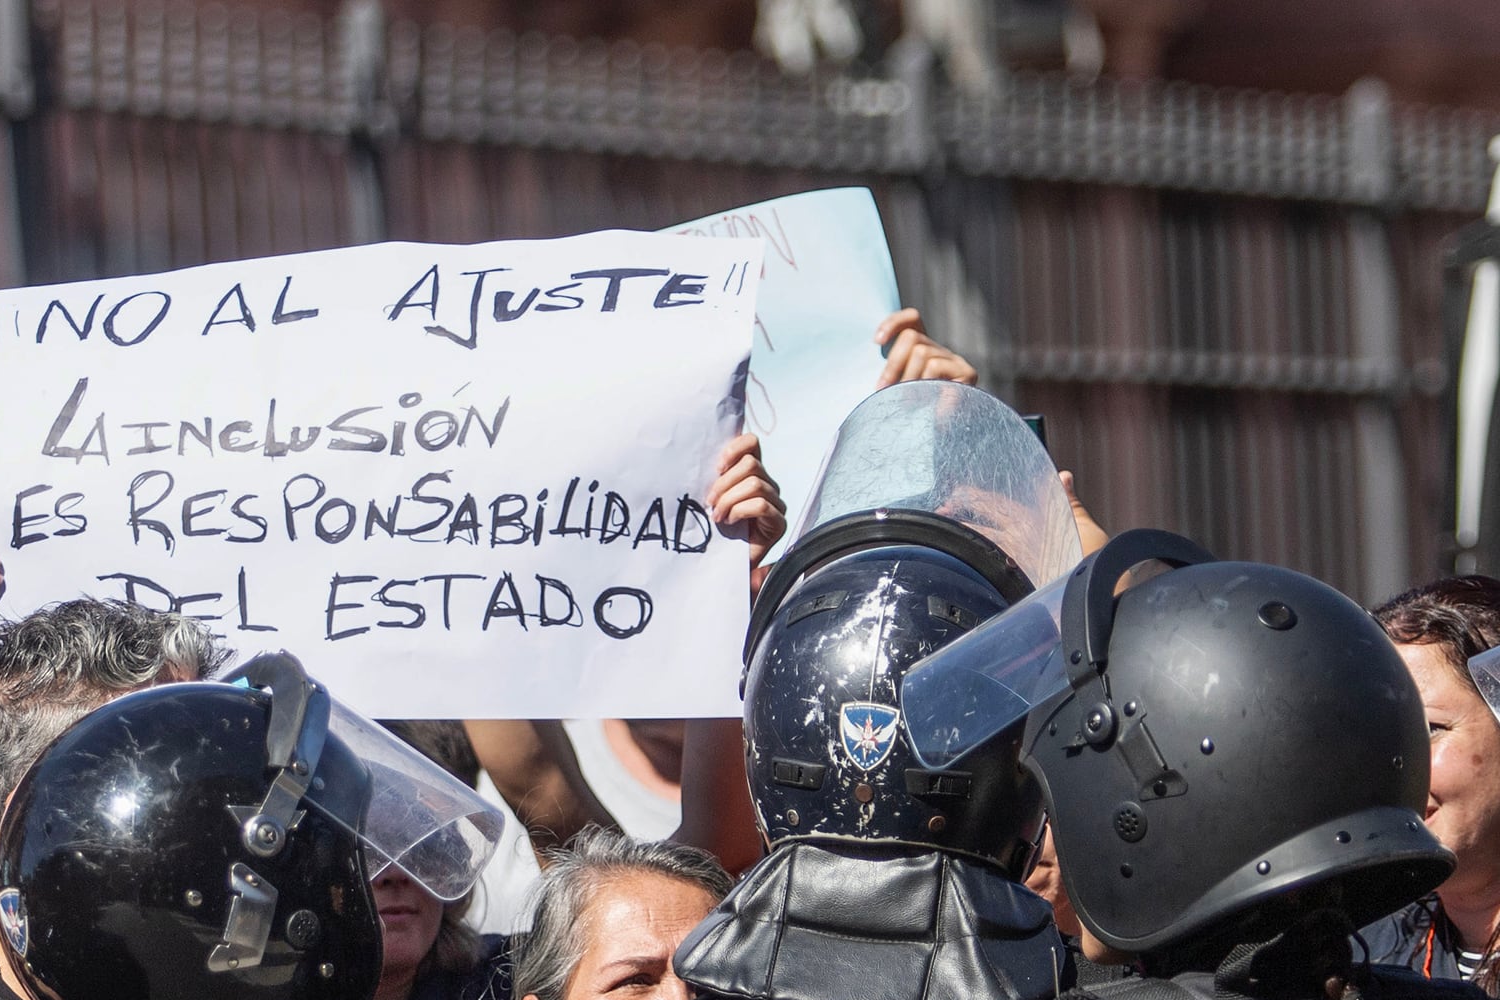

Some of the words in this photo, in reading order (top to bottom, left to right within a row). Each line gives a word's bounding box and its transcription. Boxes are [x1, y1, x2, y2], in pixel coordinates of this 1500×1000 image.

[202, 276, 319, 335] AL
[10, 484, 87, 549] ES
[96, 566, 278, 638] DEL
[325, 570, 653, 641] ESTADO
